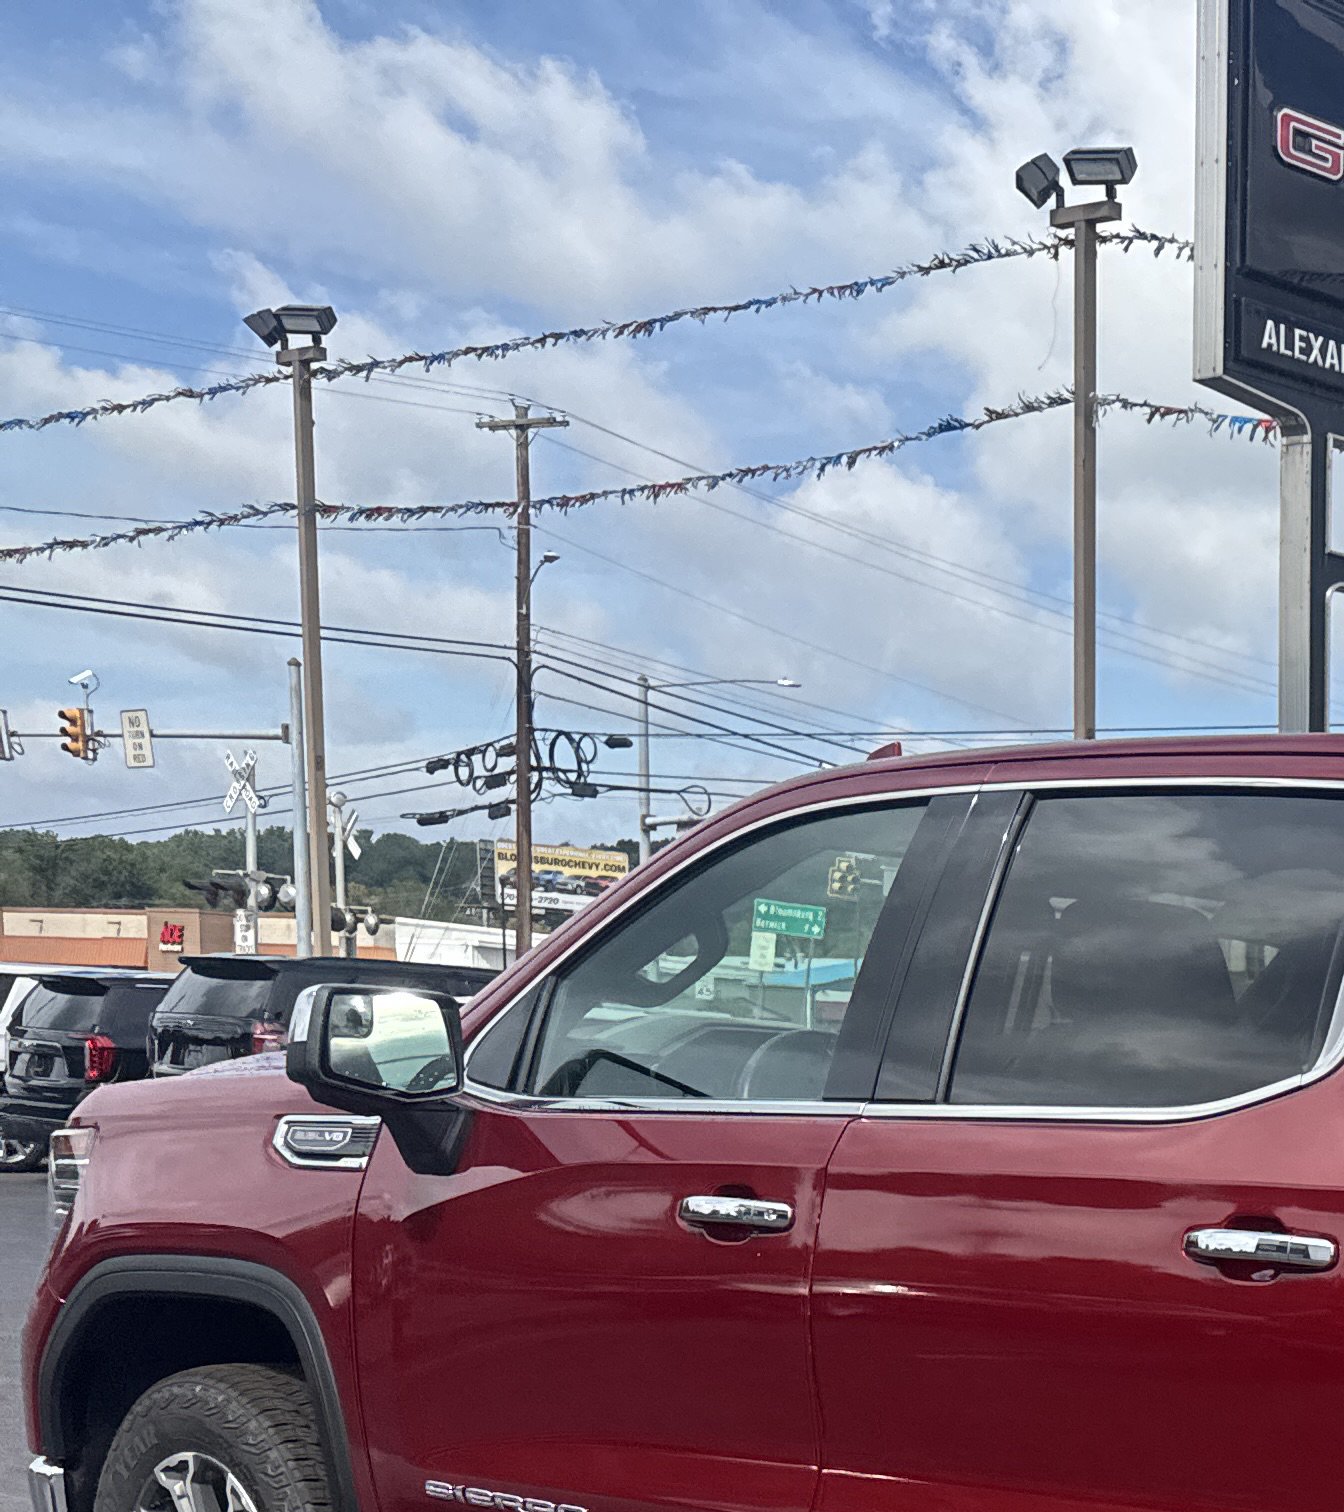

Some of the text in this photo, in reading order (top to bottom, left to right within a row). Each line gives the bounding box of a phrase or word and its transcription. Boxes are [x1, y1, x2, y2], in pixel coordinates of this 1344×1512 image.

[128, 716, 141, 728] NO
[128, 730, 145, 739] TURN
[133, 742, 143, 751] ON
[133, 754, 146, 763] RED
